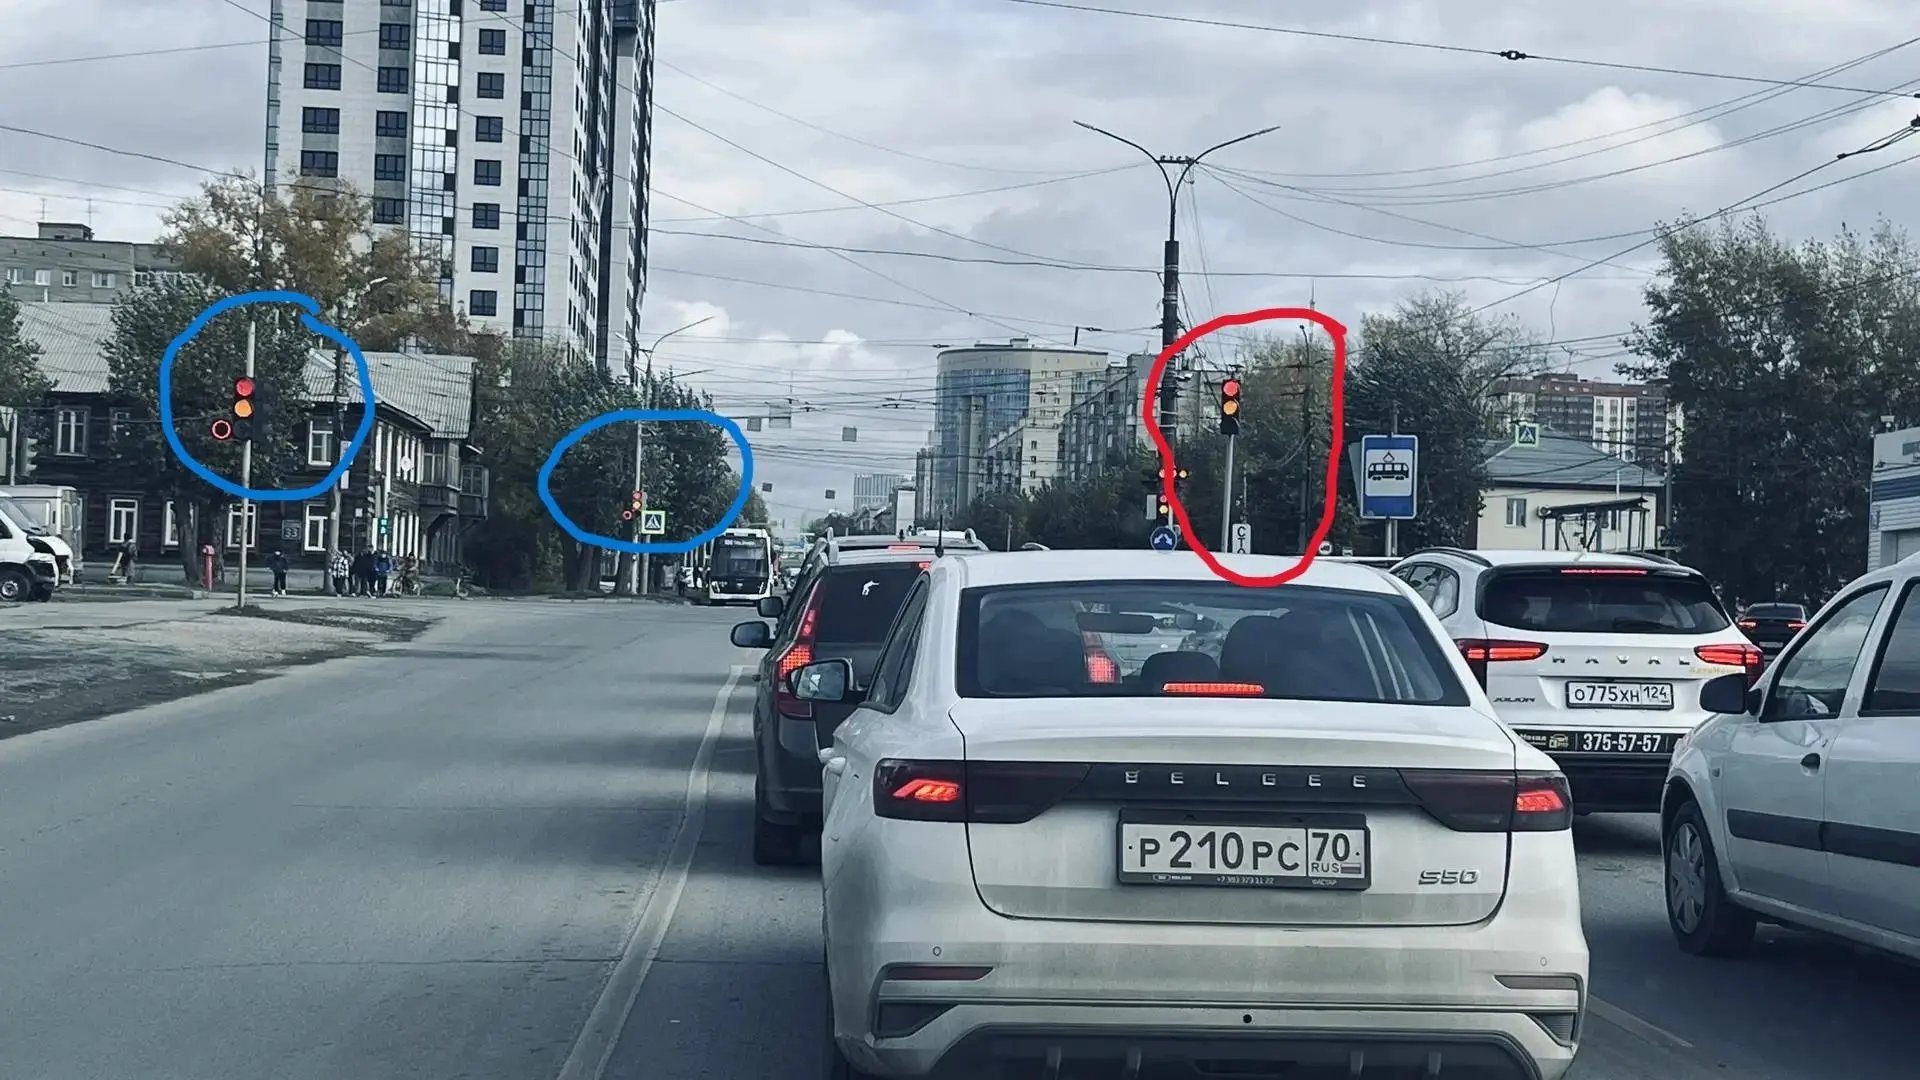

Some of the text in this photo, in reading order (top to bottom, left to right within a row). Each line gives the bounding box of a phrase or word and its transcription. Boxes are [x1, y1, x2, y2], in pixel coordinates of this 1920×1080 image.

[1552, 655, 1691, 666] HAVAL
[1643, 686, 1667, 699] 124
[1582, 733, 1662, 752] 375-57-57
[1125, 770, 1366, 788] BELGEE
[1311, 832, 1351, 862] 70
[1311, 863, 1340, 874] RUS
[1418, 868, 1478, 886] S50
